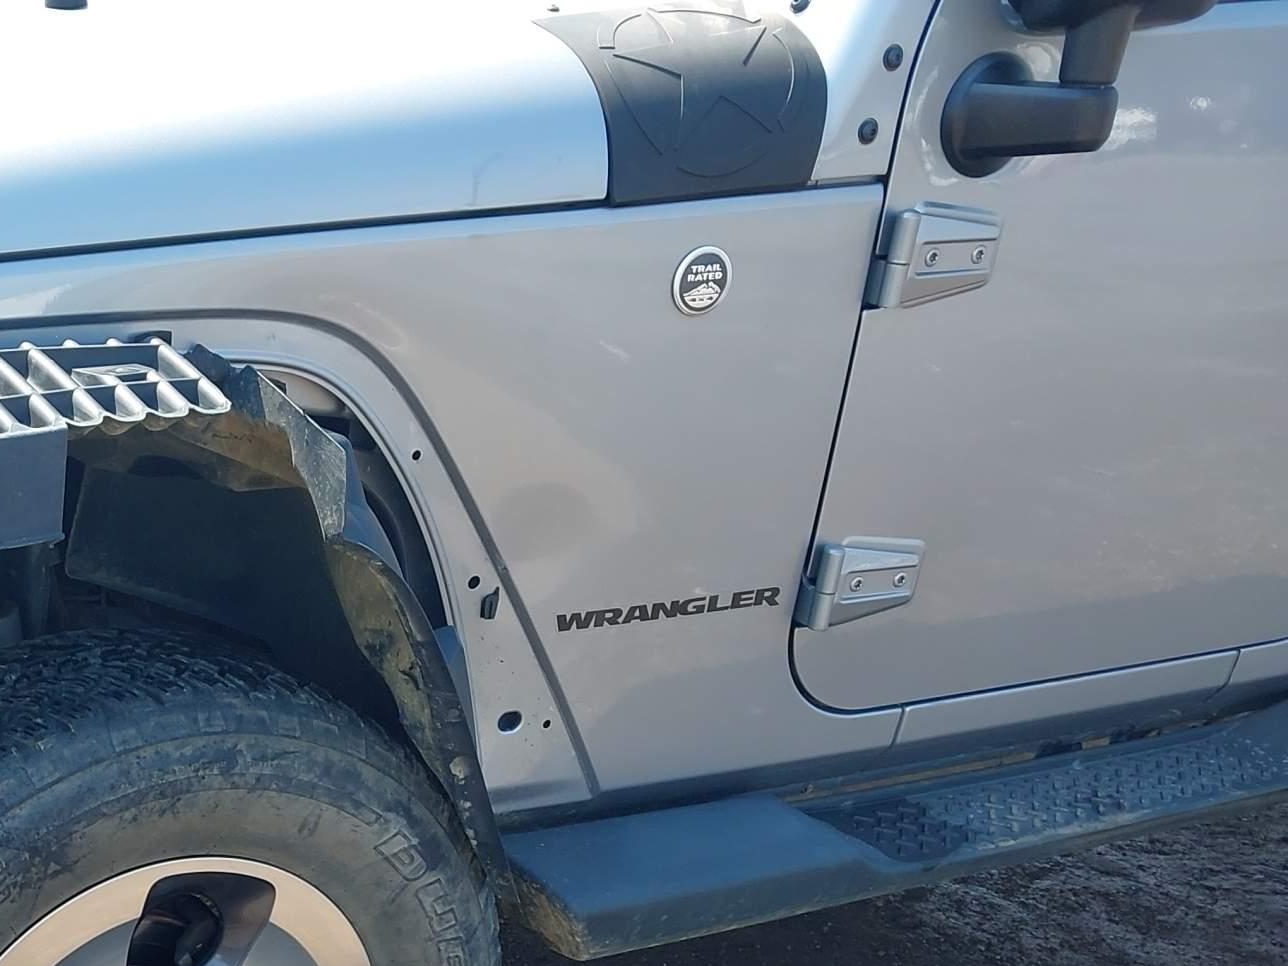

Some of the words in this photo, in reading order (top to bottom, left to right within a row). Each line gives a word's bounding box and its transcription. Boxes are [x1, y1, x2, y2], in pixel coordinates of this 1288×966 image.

[691, 263, 723, 273] TRAIL
[687, 272, 723, 282] RATED
[556, 586, 781, 632] WRANGLER
